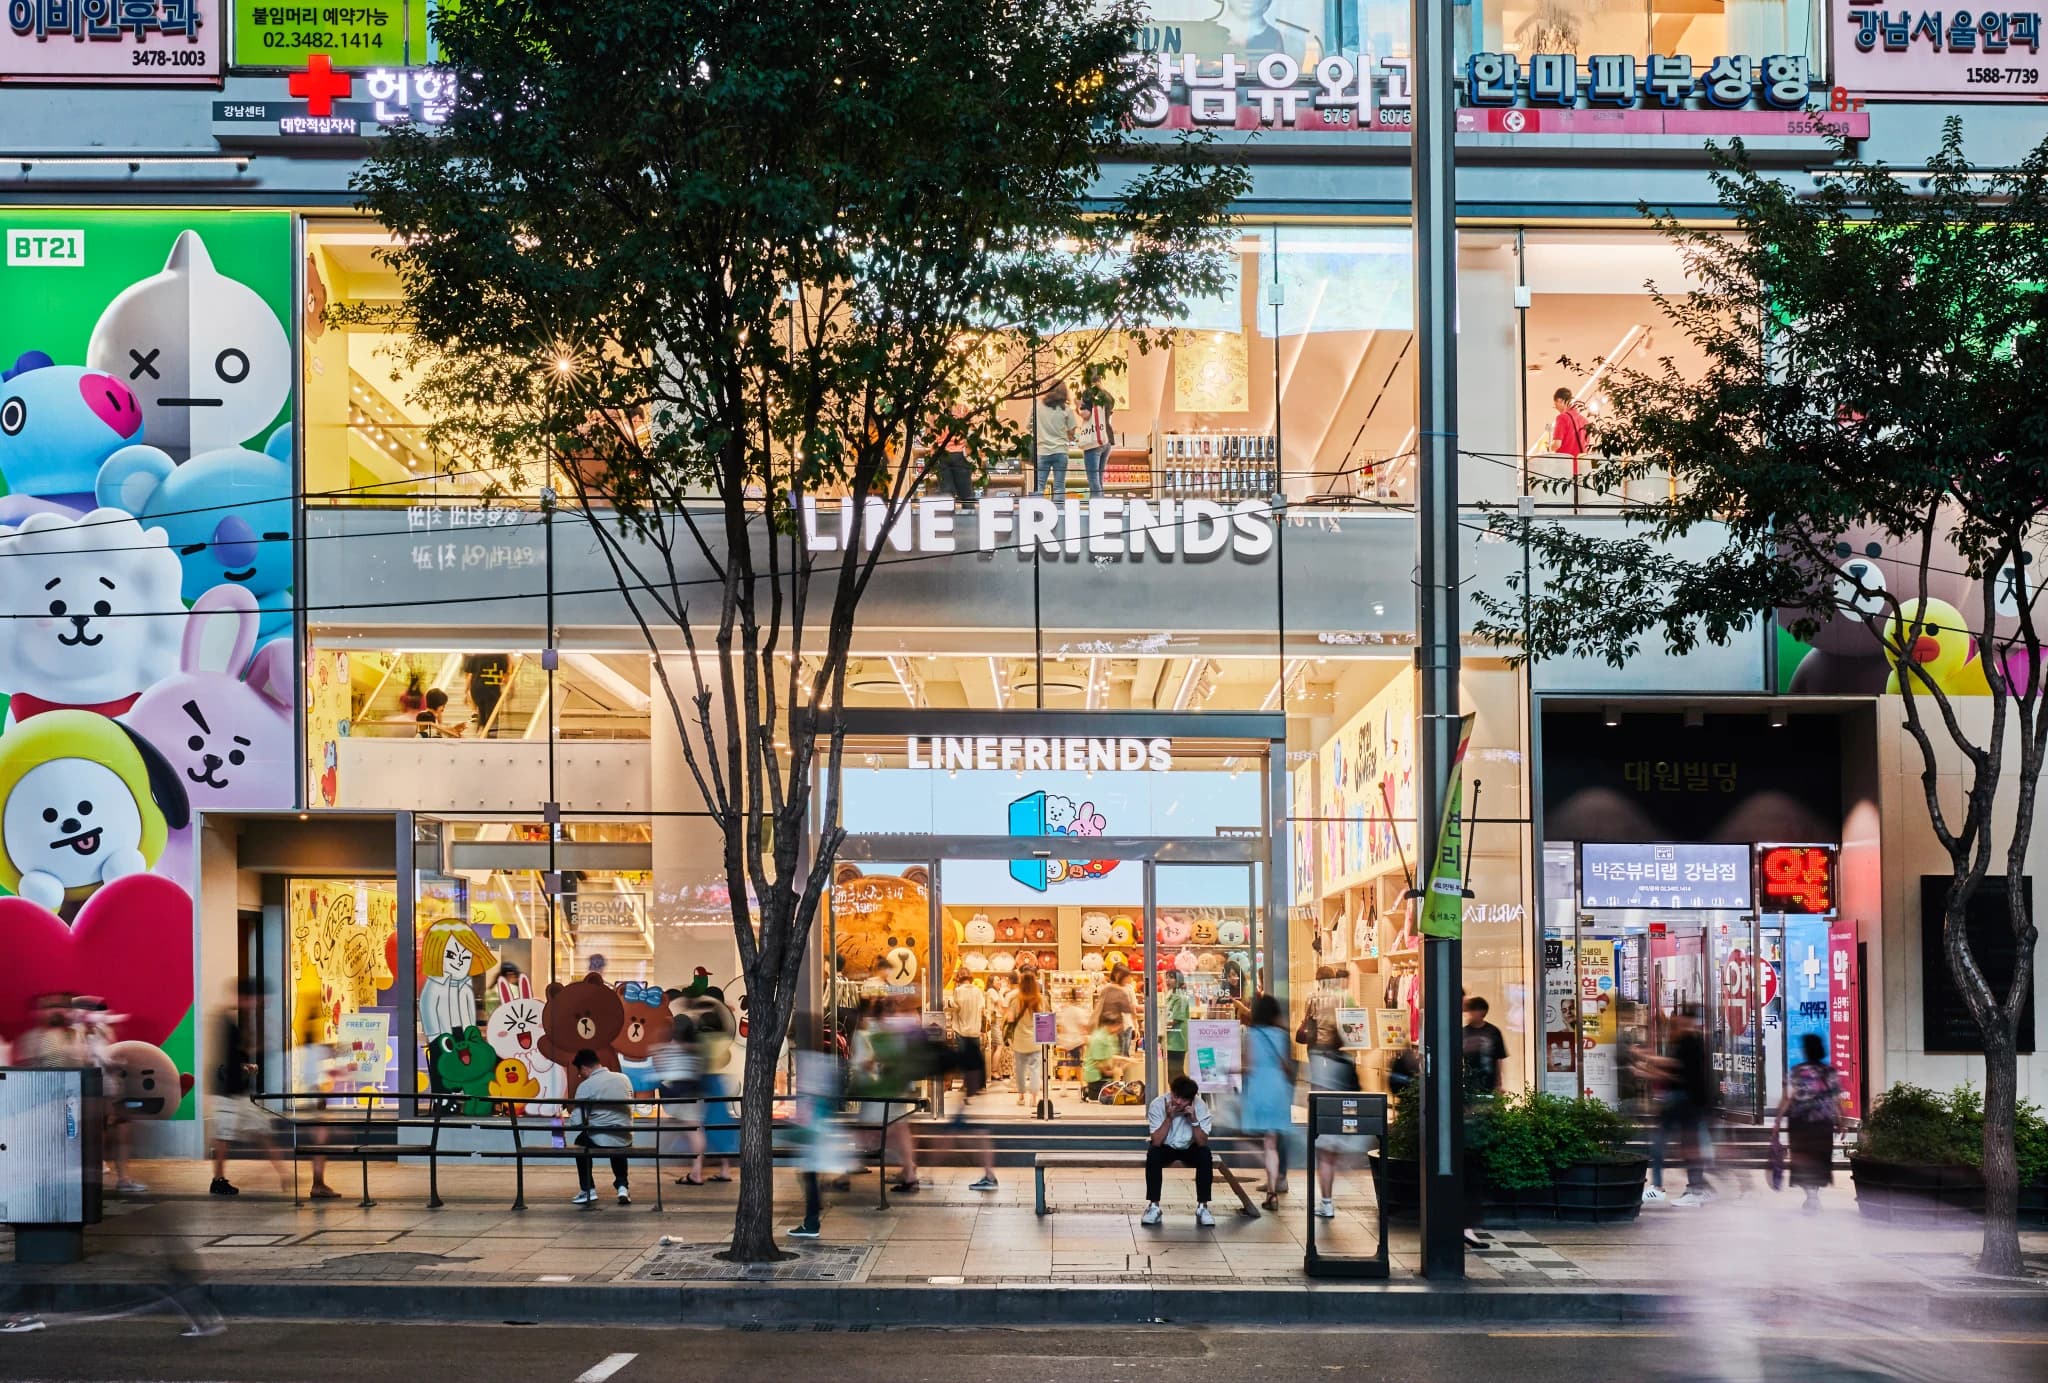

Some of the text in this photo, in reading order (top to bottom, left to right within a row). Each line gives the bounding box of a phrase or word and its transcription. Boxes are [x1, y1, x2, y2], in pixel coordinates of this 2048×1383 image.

[252, 7, 388, 26] 붙임머리 예약가능
[1850, 10, 2041, 49] 강남서울안과
[263, 32, 383, 49] 02.3482.1414
[132, 50, 206, 66] 3478-1003
[1473, 52, 1809, 104] 한미피부성형
[1966, 67, 2039, 84] 1588-7739
[223, 105, 265, 118] 강남센터
[280, 117, 356, 134] 대한적십자사
[15, 238, 76, 259] BT21
[802, 496, 955, 553] LINE
[978, 498, 1273, 559] FRIENDS
[907, 738, 1172, 771] LINEFRIENDS
[1624, 761, 1737, 792] 대원빌딩
[1592, 862, 1736, 881] 박준뷰티랩 강남점
[570, 901, 635, 913] BROWN
